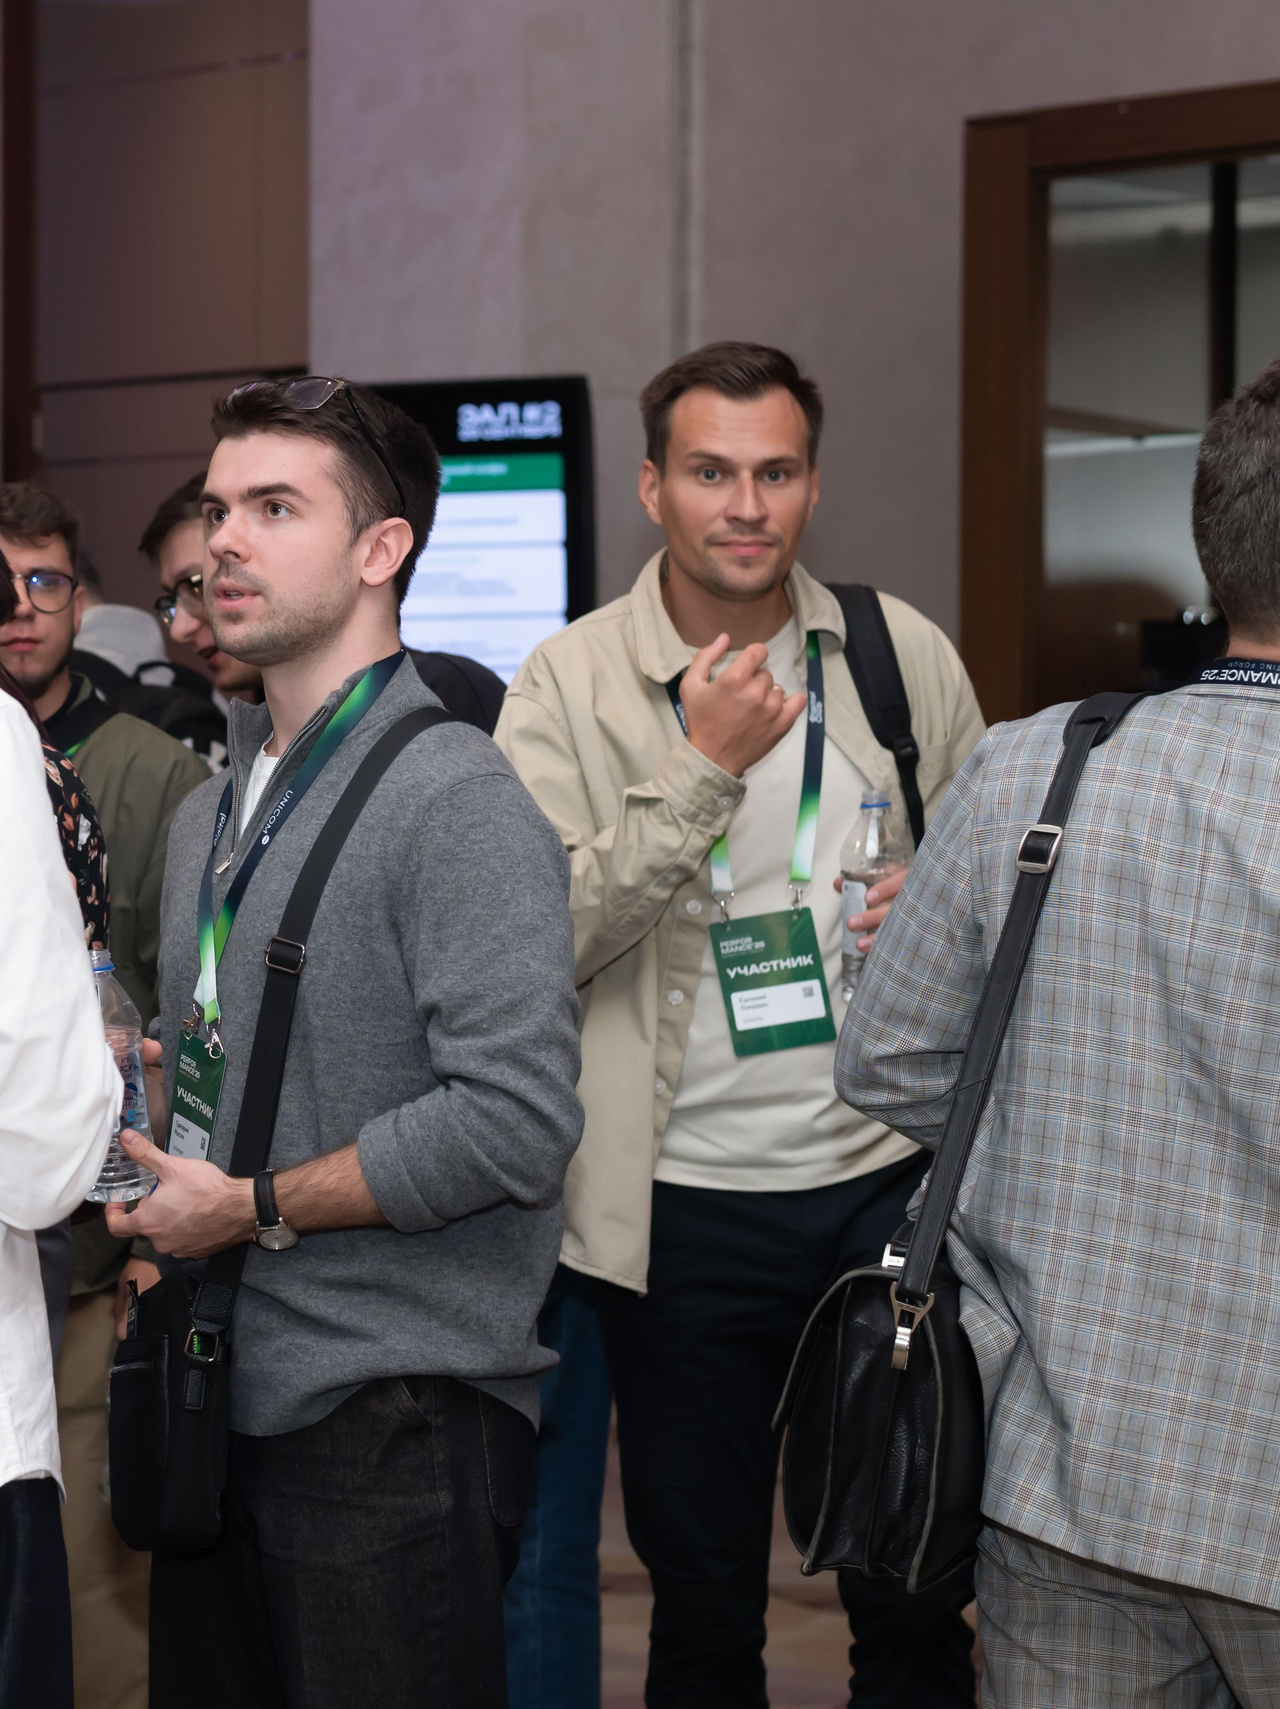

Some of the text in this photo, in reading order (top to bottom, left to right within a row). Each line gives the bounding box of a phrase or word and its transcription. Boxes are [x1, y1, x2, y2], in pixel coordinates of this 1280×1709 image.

[1228, 661, 1256, 669] FORUM
[1200, 669, 1280, 685] MANCE'25
[262, 790, 294, 834] UNICOM
[726, 954, 814, 979] УЧАСТНИК
[180, 1053, 197, 1068] PERFOR
[177, 1085, 214, 1120] УЧАСТНИК
